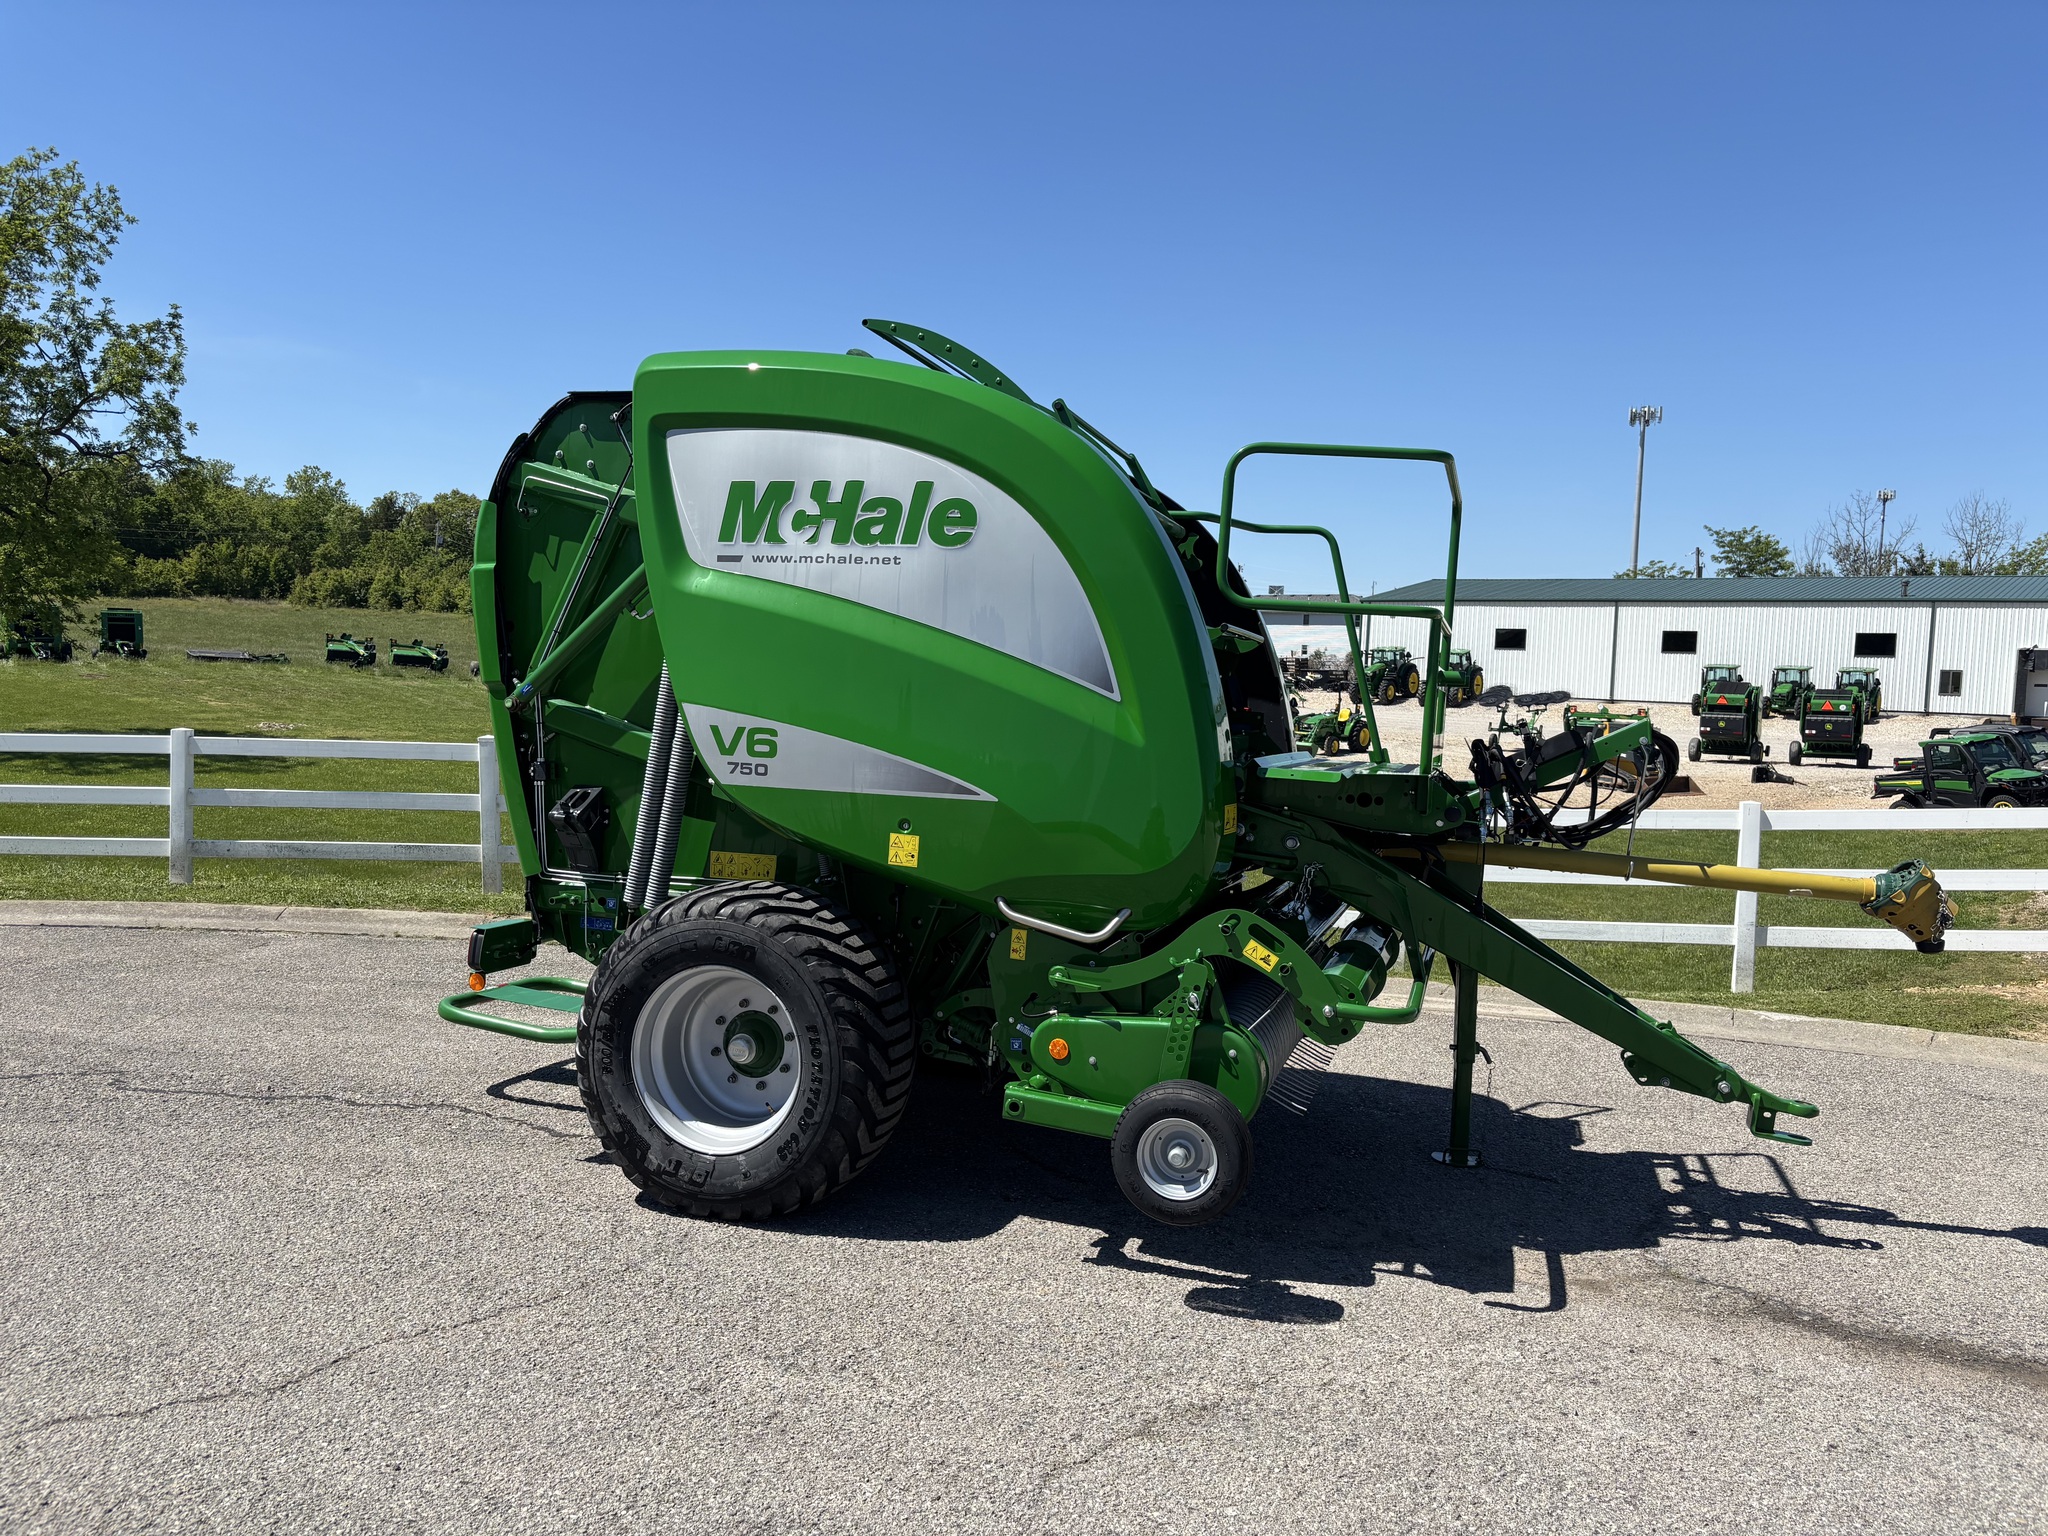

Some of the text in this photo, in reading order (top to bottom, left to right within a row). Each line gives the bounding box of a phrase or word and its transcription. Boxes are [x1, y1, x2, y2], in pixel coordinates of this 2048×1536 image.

[718, 480, 979, 548] McHale
[751, 553, 901, 565] www.mchale.net
[709, 724, 779, 759] V6
[727, 761, 769, 777] 750
